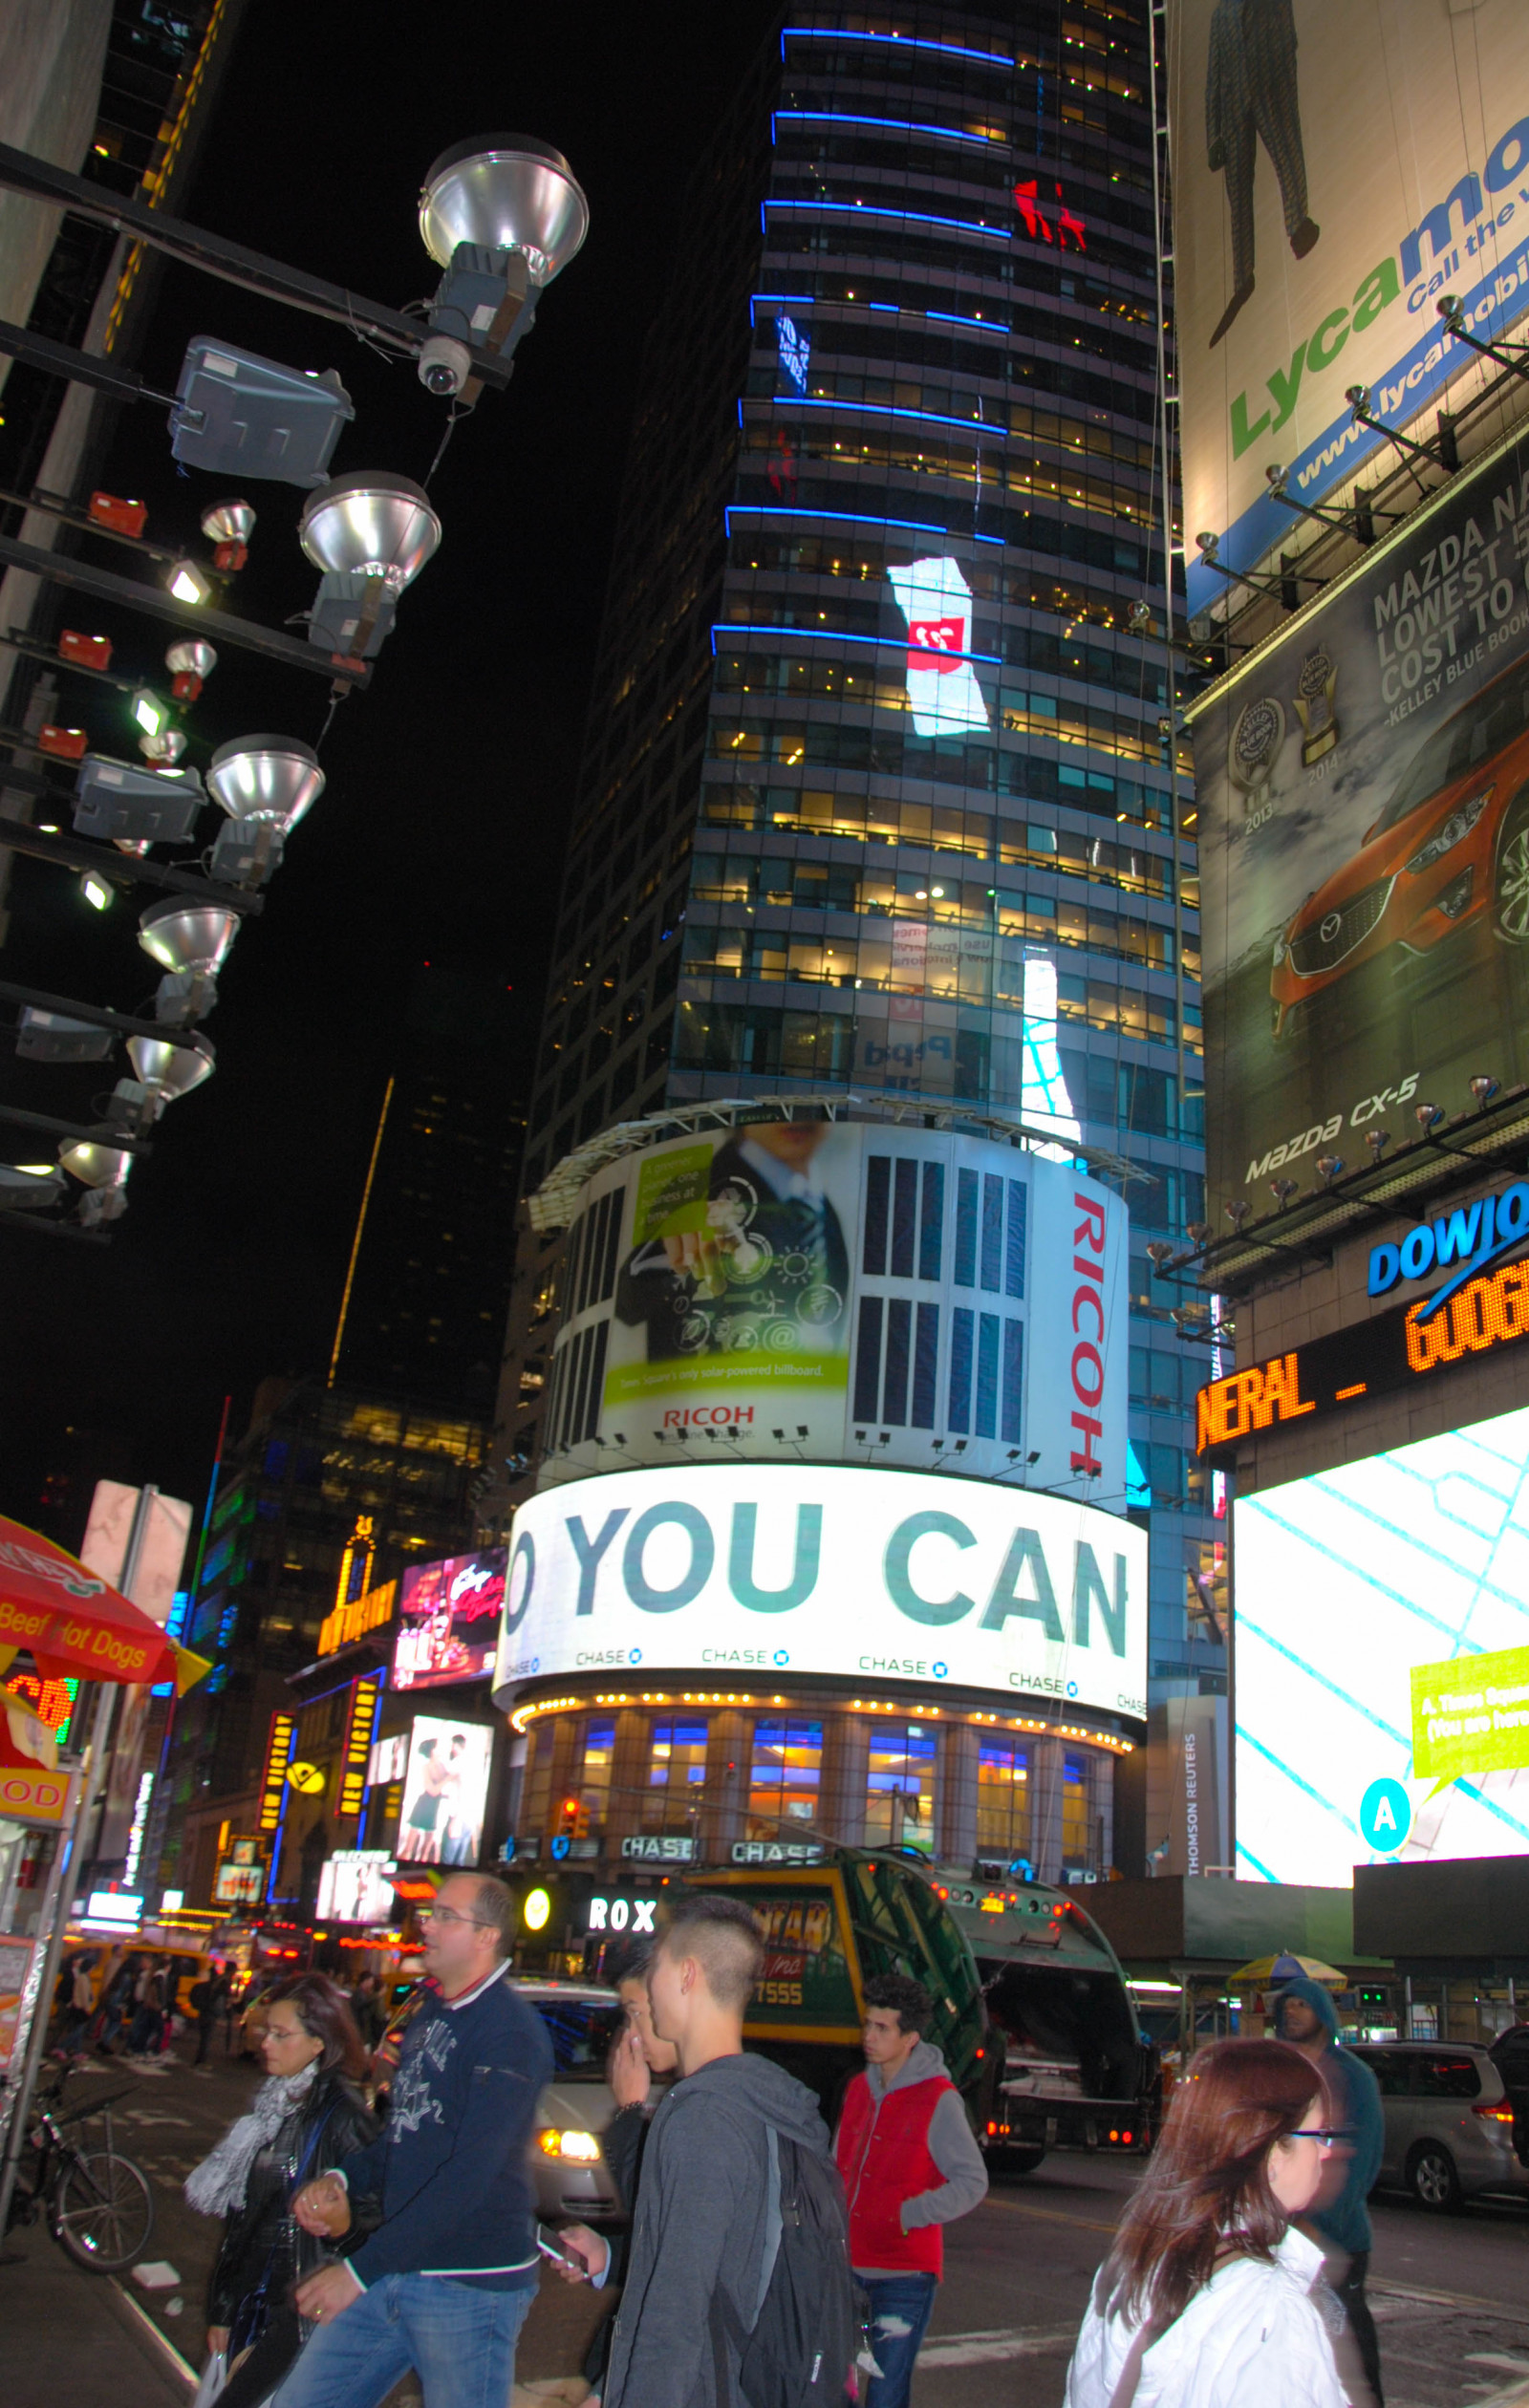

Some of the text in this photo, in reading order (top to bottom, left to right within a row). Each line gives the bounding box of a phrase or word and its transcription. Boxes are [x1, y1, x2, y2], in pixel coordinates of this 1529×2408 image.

[1408, 203, 1515, 314] Call the
[1230, 116, 1529, 462] Lycamo
[1297, 247, 1529, 489] www.lycamobi
[1374, 517, 1485, 631] MAZDA
[1377, 539, 1501, 668] LOWEST
[1381, 614, 1460, 704] COST
[1469, 577, 1514, 635] TO
[1447, 642, 1485, 685] BLUE
[1488, 607, 1529, 653] BOOK
[1308, 752, 1339, 787] 2014
[1245, 802, 1274, 836] 2013
[1349, 1072, 1421, 1127] CX-5
[678, 1171, 700, 1184] one
[683, 1187, 696, 1198] at
[1069, 1192, 1107, 1480] RICOH
[679, 1367, 699, 1381] only
[701, 1365, 771, 1378] solar-powered
[774, 1364, 825, 1377] billboard.
[663, 1406, 754, 1429] RICOH
[565, 1500, 825, 1617] YOU
[882, 1510, 1129, 1659] CAN
[0, 1602, 147, 1669] Beef Hot Dogs
[576, 1649, 625, 1666] CHASE
[701, 1648, 767, 1664] CHASE
[859, 1656, 927, 1674] CHASE
[1009, 1672, 1064, 1693] CHASE
[1117, 1694, 1148, 1716] CHASE
[340, 1681, 377, 1814] NEW VICTORY
[1186, 1732, 1198, 1876] THOMSON REUTERS
[1373, 1796, 1397, 1832] A
[622, 1837, 694, 1860] CHASE
